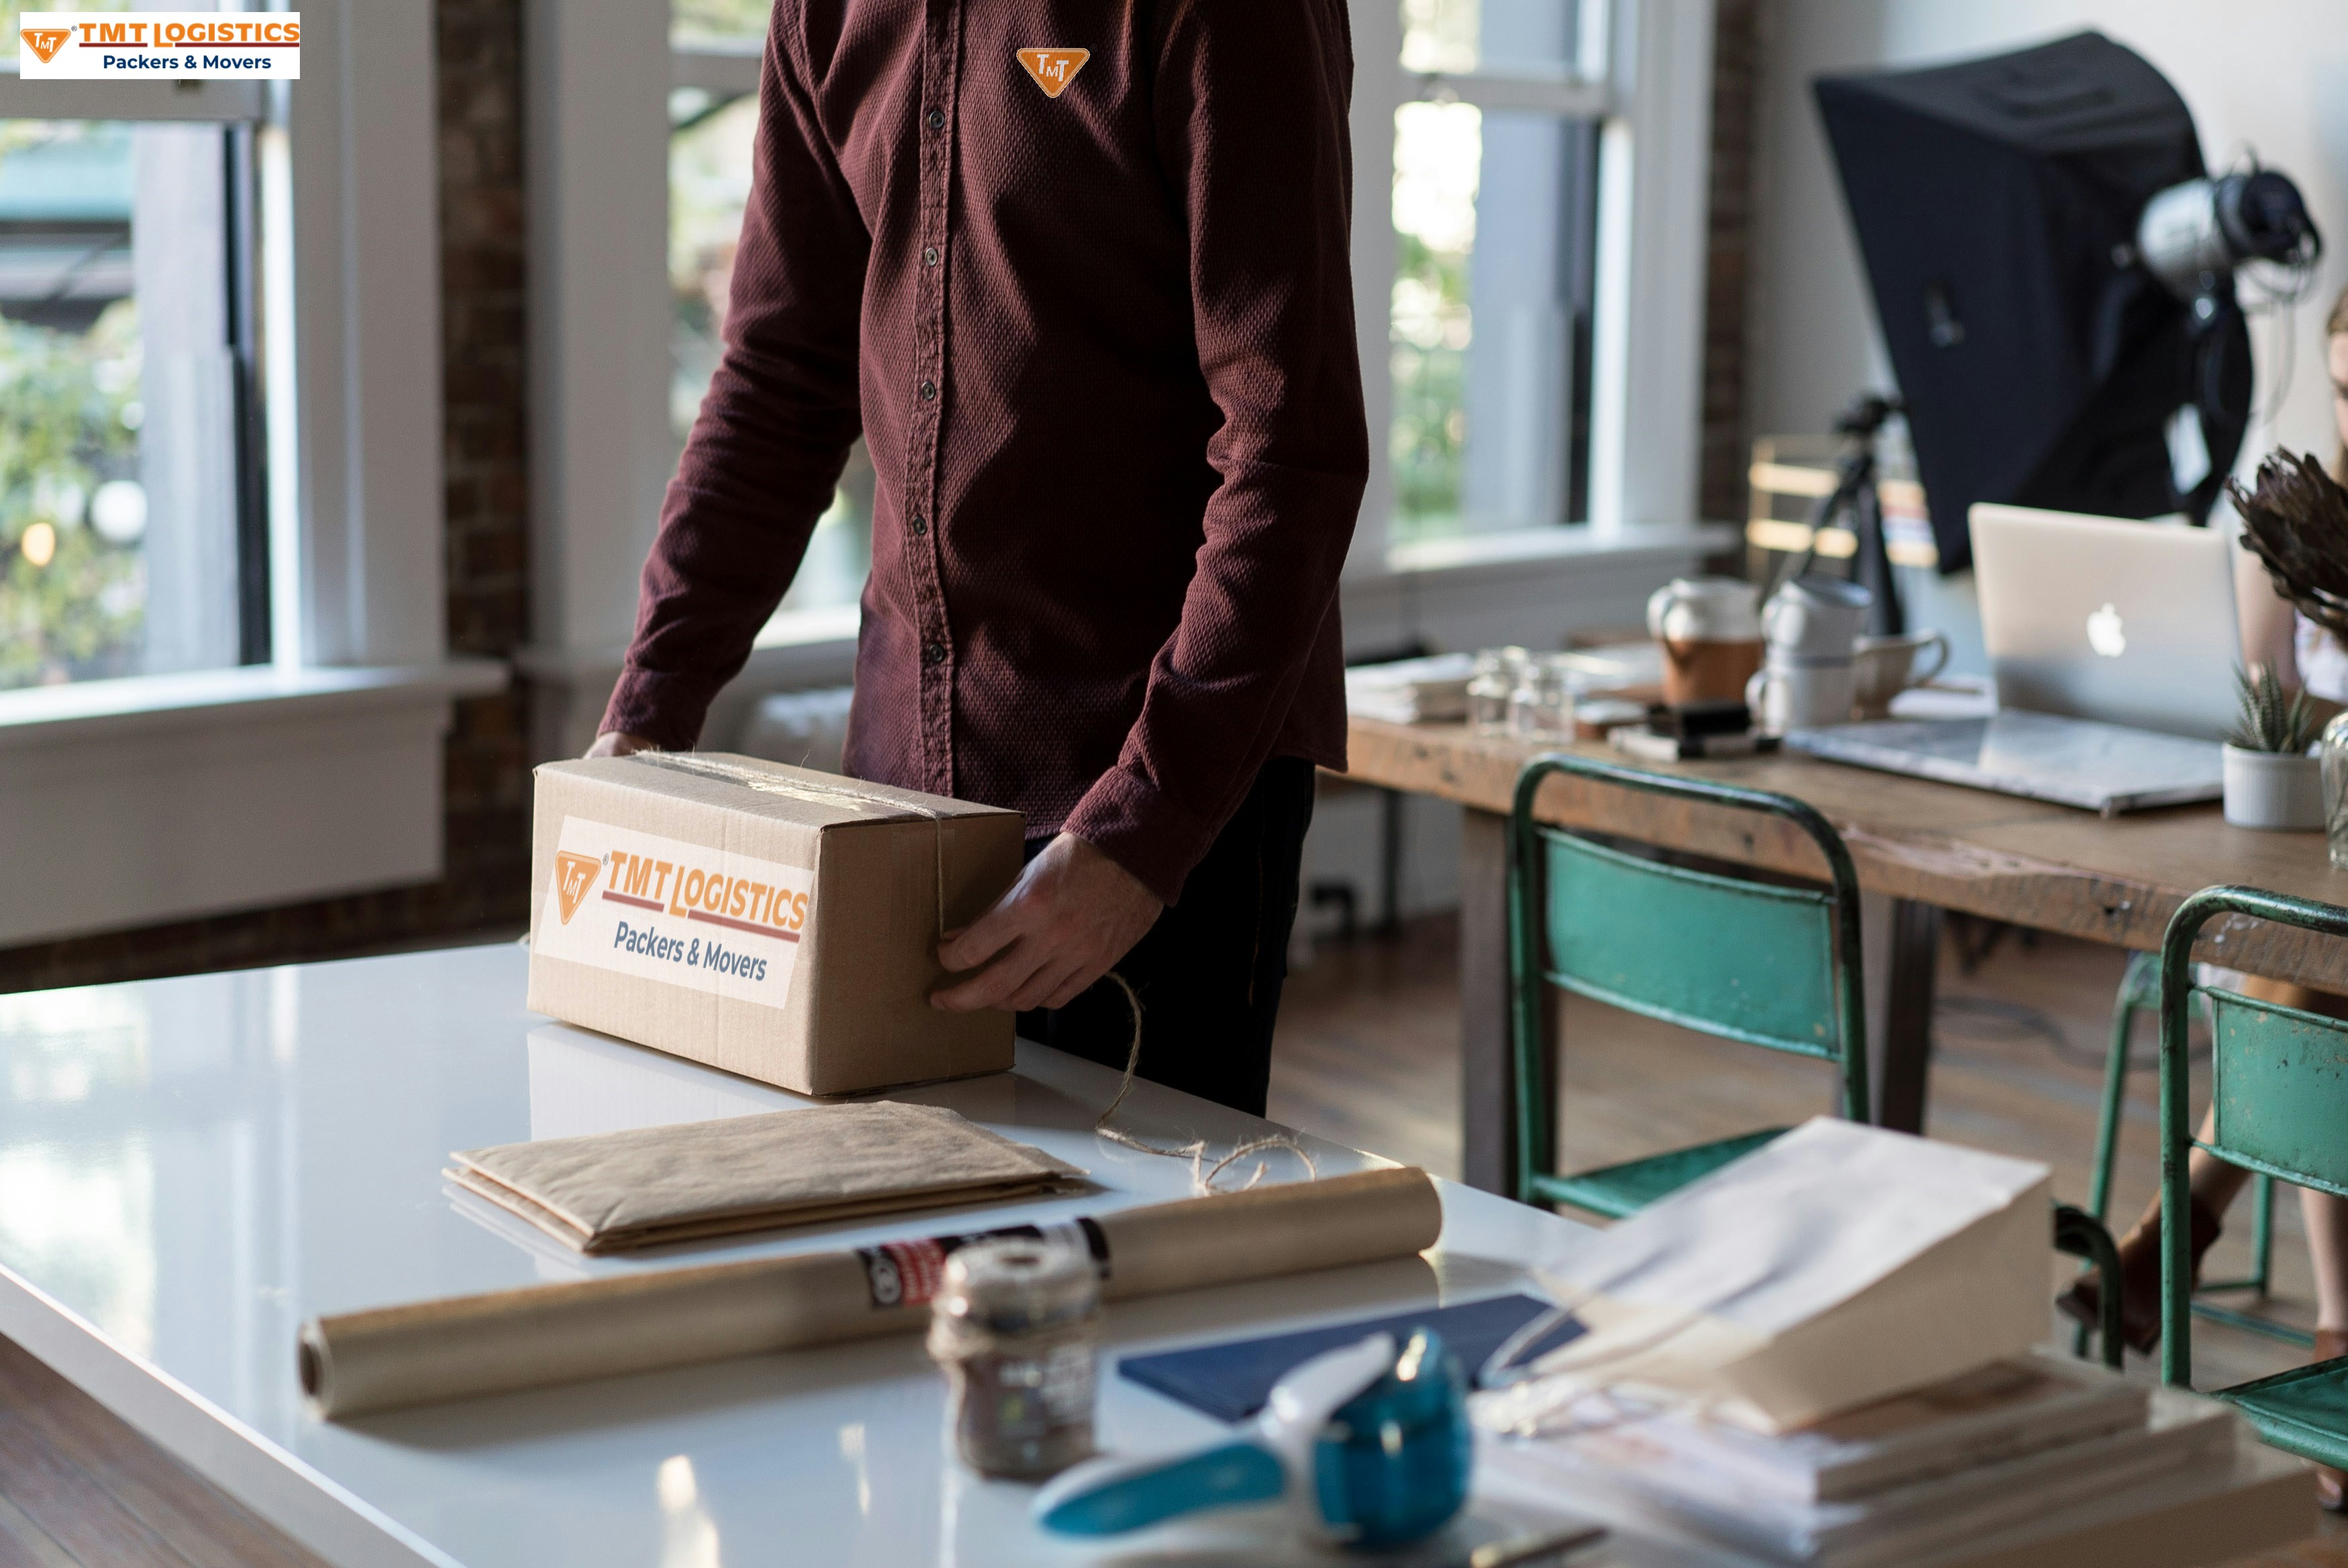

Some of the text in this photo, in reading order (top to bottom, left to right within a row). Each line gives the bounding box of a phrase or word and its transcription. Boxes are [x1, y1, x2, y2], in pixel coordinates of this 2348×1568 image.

[1036, 54, 1069, 82] TMT
[563, 861, 586, 904] TMT
[608, 850, 809, 931] TMT LOGISTICS
[613, 920, 767, 981] Packers & Movers
